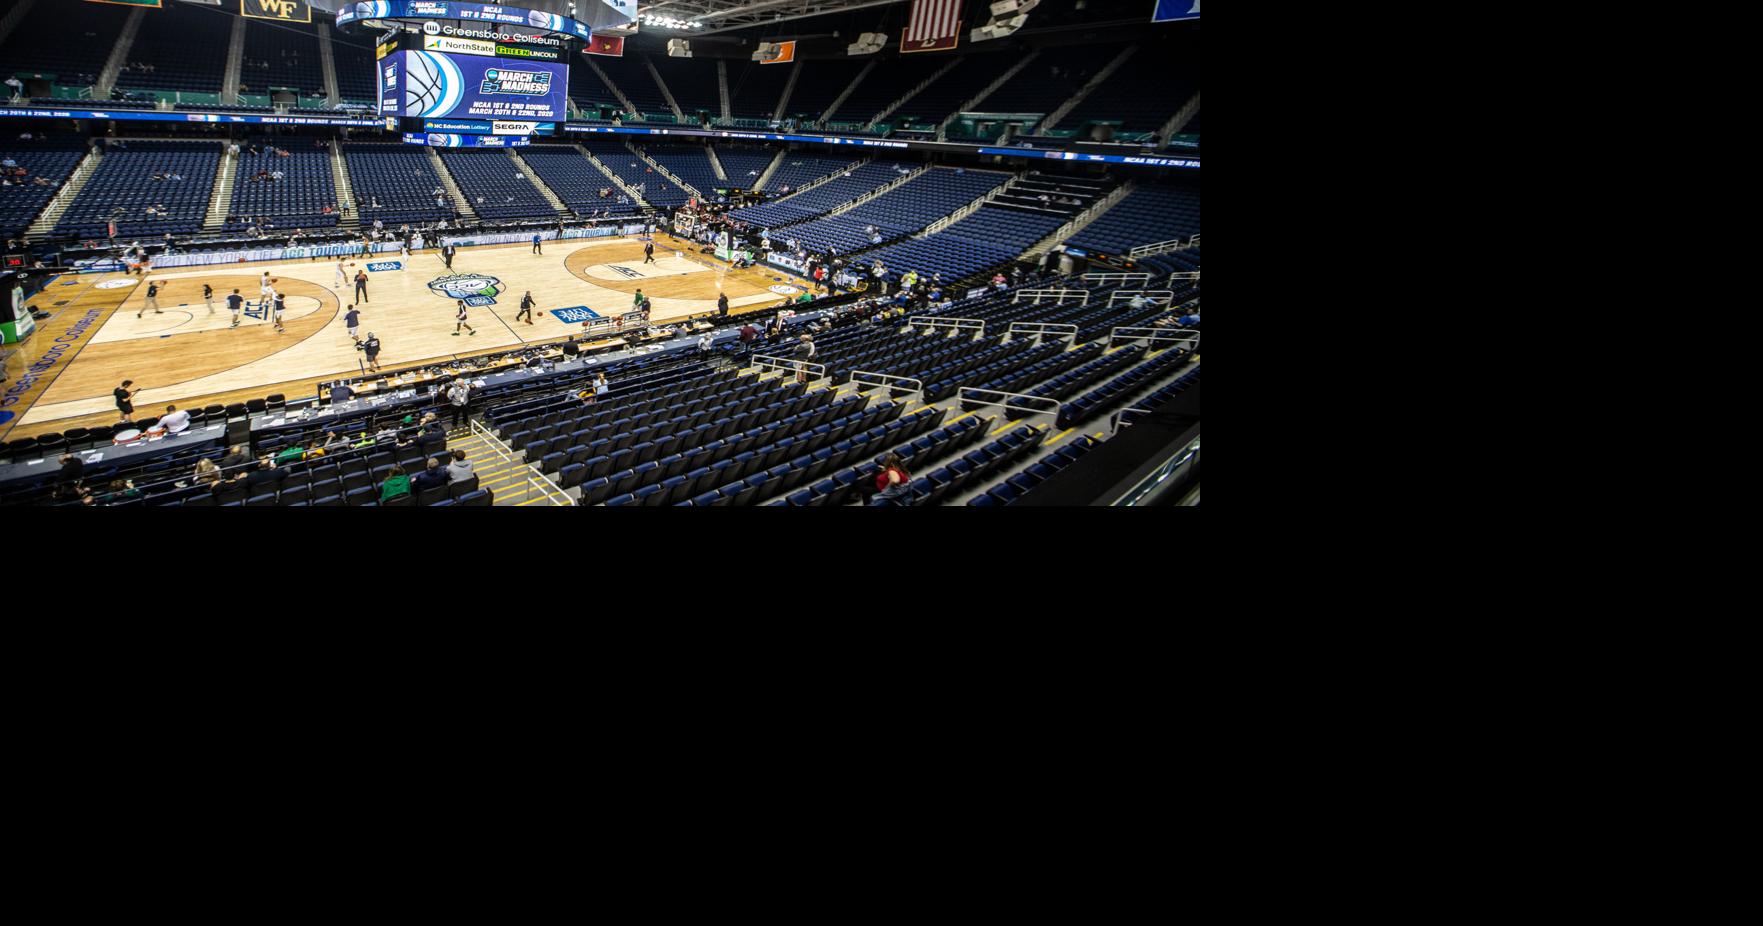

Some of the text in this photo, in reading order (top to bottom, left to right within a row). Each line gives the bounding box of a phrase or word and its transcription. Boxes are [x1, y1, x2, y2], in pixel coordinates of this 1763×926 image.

[258, 0, 297, 18] WF
[496, 14, 524, 22] ROUNDS
[443, 25, 560, 46] Greensboro Coliseum
[446, 41, 494, 52] NorthState
[498, 72, 533, 82] MARCH
[501, 81, 549, 91] MADNESS
[281, 242, 384, 259] ACC TOURNAMNT
[186, 254, 214, 266] NEW
